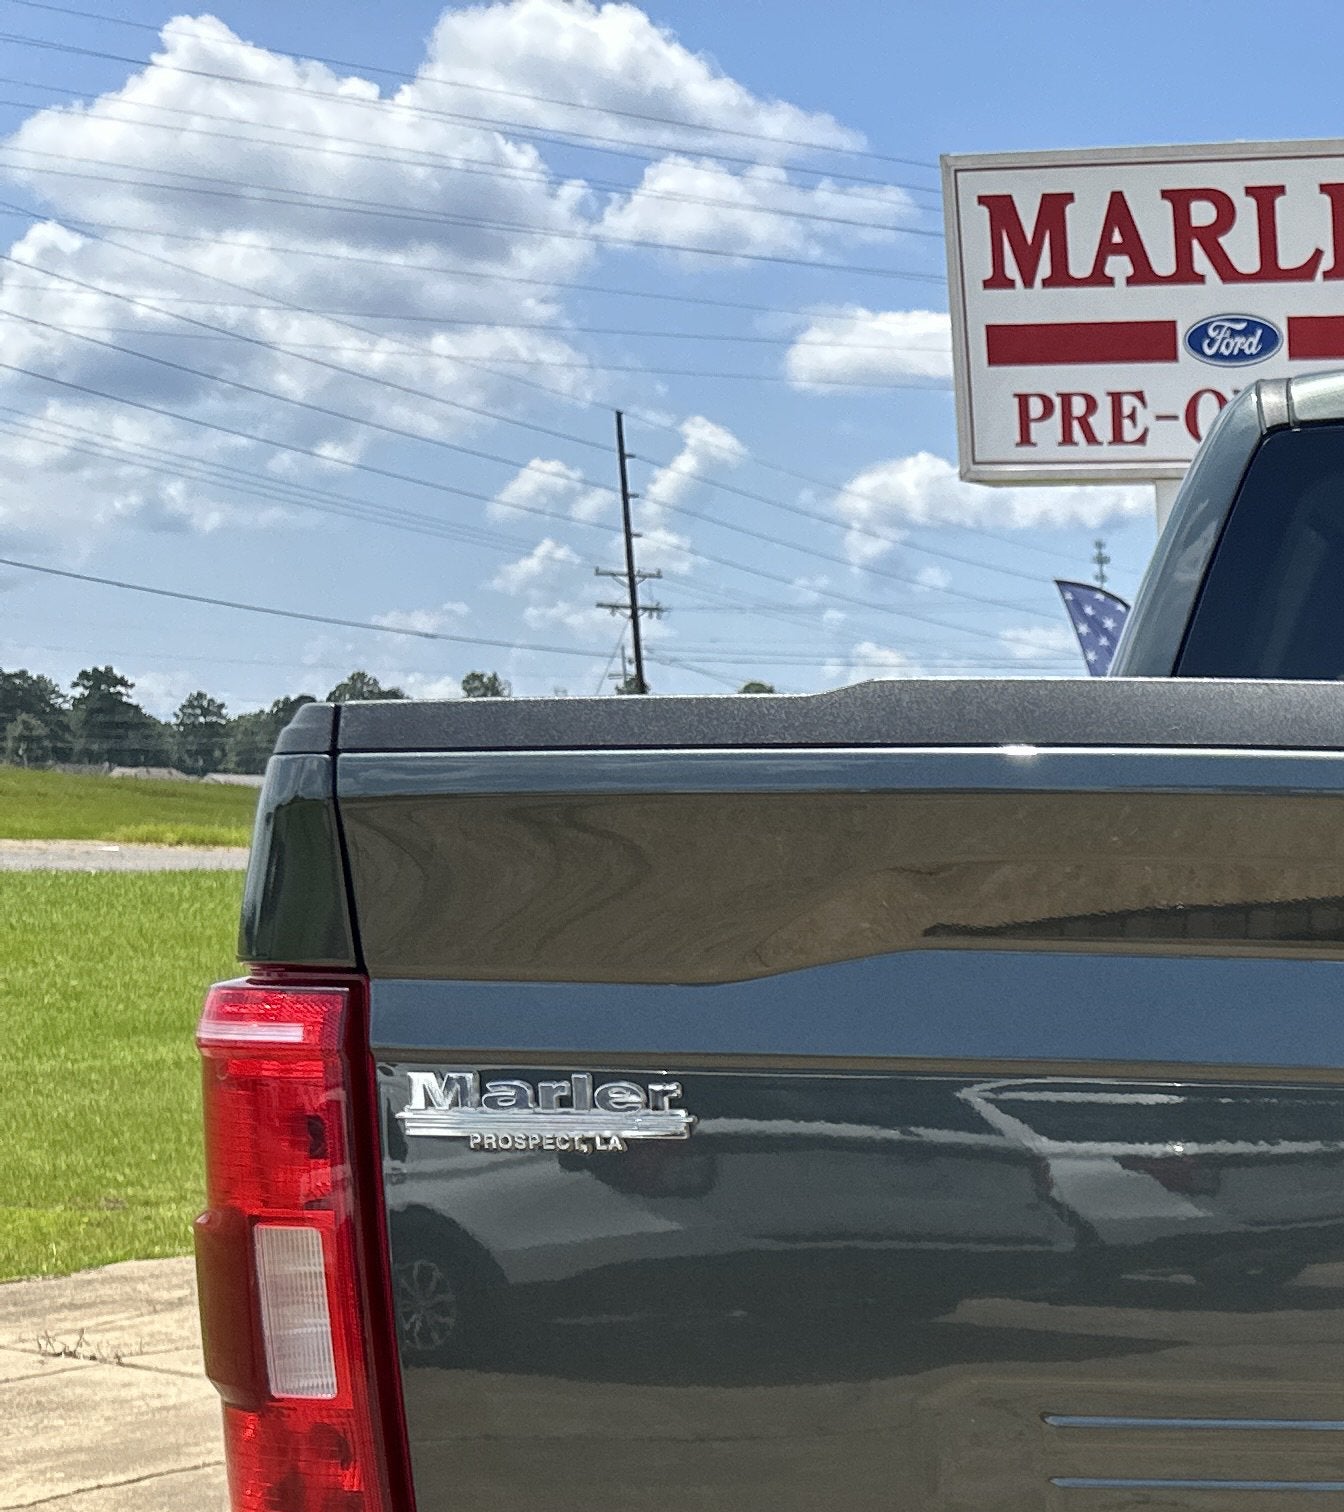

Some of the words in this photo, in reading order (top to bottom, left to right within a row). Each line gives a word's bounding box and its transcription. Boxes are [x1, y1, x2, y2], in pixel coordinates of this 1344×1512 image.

[1202, 321, 1262, 356] Ford
[1013, 387, 1240, 447] PRE-O
[404, 1070, 683, 1112] Marler
[468, 1132, 592, 1154] PROSPECT,
[594, 1133, 628, 1152] LA
